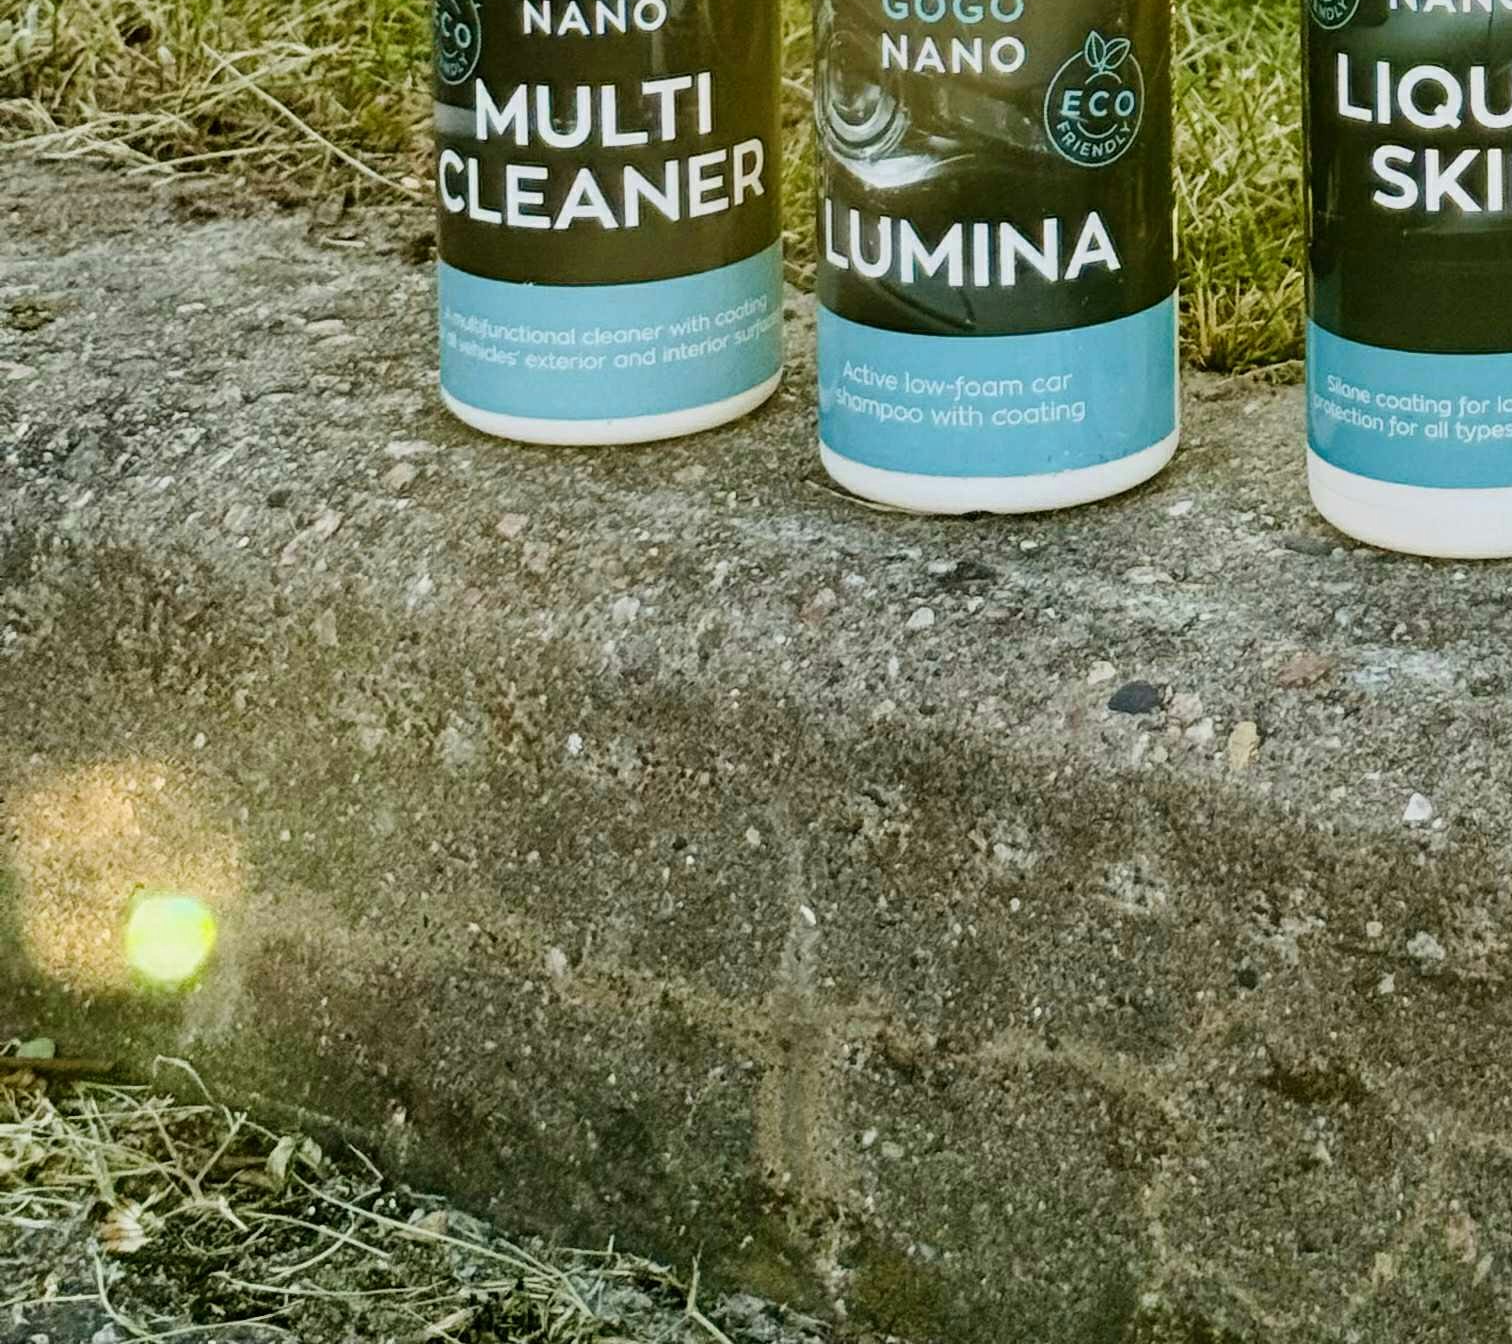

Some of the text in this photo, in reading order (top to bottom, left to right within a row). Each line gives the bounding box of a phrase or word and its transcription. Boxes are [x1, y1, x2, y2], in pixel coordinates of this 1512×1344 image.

[881, 32, 1026, 74] NANO
[475, 72, 712, 148] MULTI
[1060, 90, 1135, 117] ECO
[1056, 120, 1131, 158] FRIENDLY
[438, 138, 766, 230] CLEANER
[825, 198, 1121, 287] LUMINA
[582, 324, 663, 346] cleaner
[669, 313, 711, 337] with
[714, 294, 769, 327] coating
[525, 351, 607, 369] exterior
[613, 346, 657, 369] and
[662, 334, 731, 364] interior
[842, 359, 1073, 401] Active low-foam car
[835, 385, 1086, 428] shampoo with coating
[1375, 393, 1452, 418] coating
[1457, 396, 1490, 417] for
[1387, 415, 1418, 437] for
[1424, 421, 1449, 439] all
